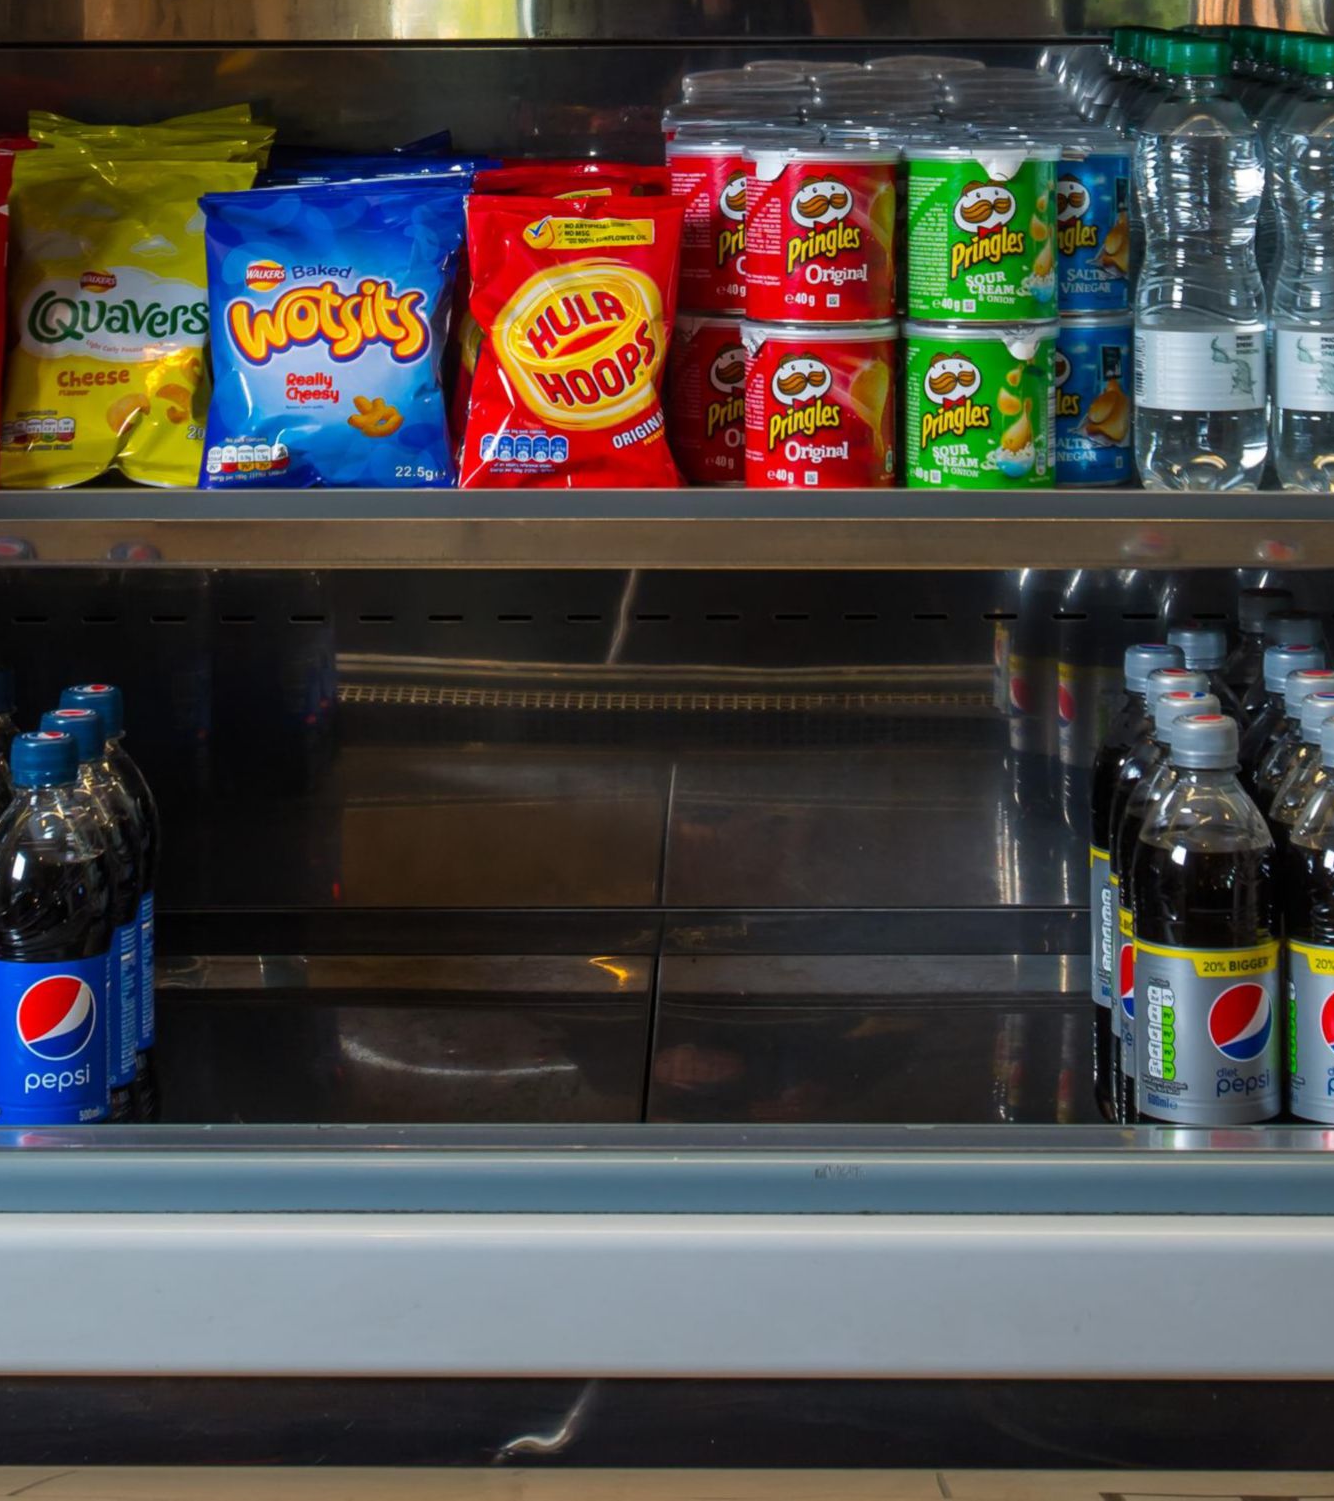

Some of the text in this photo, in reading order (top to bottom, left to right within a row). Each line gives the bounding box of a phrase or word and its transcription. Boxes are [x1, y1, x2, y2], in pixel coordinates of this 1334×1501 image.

[786, 221, 862, 274] Pringles
[950, 225, 1025, 280] Pringles
[79, 274, 117, 289] WALKERS
[245, 263, 353, 282] WALKERS Baked
[805, 263, 868, 286] Original
[965, 271, 1007, 285] SOUR
[968, 283, 1015, 295] CREAM
[1060, 281, 1112, 294] VINEGAR
[986, 295, 1016, 305] ONION
[27, 289, 210, 344] Quavers
[525, 290, 628, 361] HULA
[534, 318, 656, 408] HOOPS
[57, 369, 131, 388] Cheese
[285, 371, 334, 389] Really
[285, 386, 340, 404] Cheesy
[768, 398, 841, 451] Pringles
[921, 399, 990, 450] Pringles
[784, 441, 849, 463] Original
[931, 444, 971, 459] SOUR
[934, 456, 979, 469] CREAM
[394, 465, 434, 481] 22.5g
[950, 468, 979, 478] ONION
[1202, 955, 1269, 973] 20% BIGGER
[24, 1062, 91, 1094] pepsi
[1216, 1066, 1239, 1079] diet
[1216, 1070, 1270, 1097] pepsi
